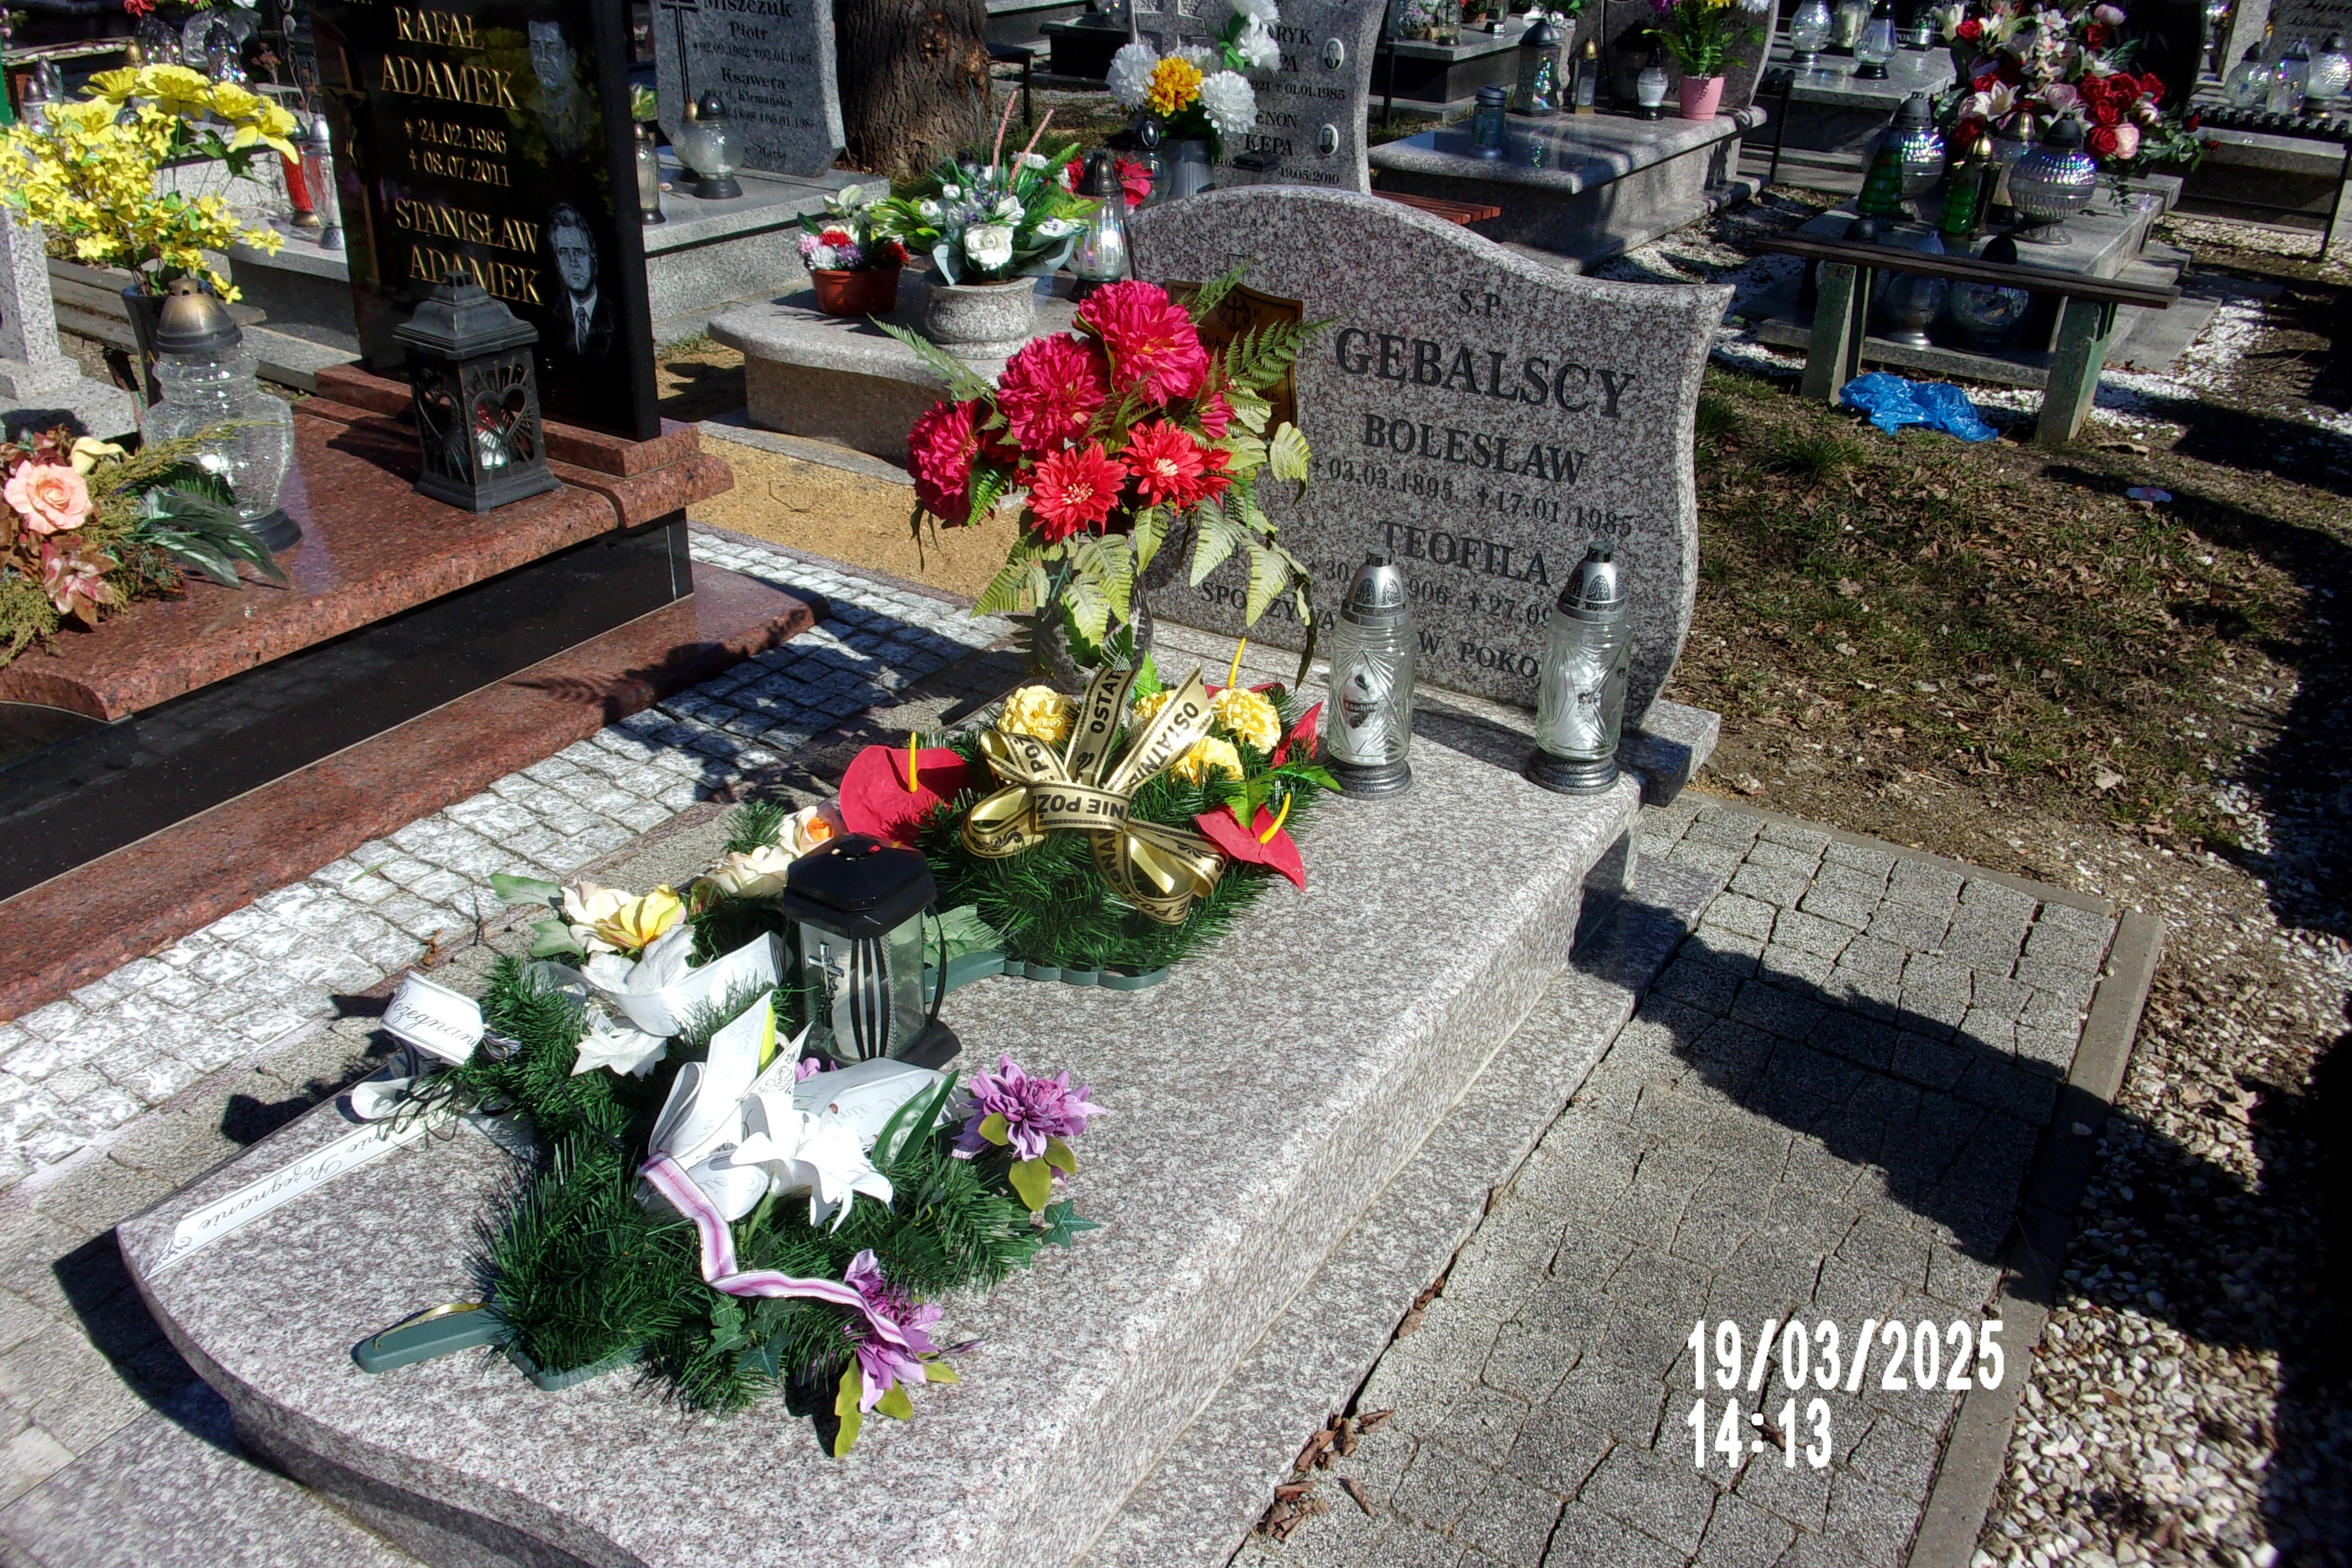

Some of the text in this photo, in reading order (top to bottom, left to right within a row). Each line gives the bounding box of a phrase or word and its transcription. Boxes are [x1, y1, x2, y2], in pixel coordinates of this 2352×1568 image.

[394, 6, 484, 50] RAFAŁ
[730, 21, 769, 40] Piotr
[380, 54, 520, 110] ADAMEK
[721, 67, 787, 91] Ksawera
[1285, 83, 1345, 100] 01.01.1985
[419, 118, 507, 154] 24.02.1986
[1256, 110, 1298, 129] ENON
[424, 155, 510, 187] 08.07.2011
[394, 198, 540, 254] STANISŁAW
[409, 244, 545, 306] ADAMEK
[1329, 458, 1633, 537] 03.03.1895 17.01.1985
[1379, 520, 1551, 587] TEOFILA
